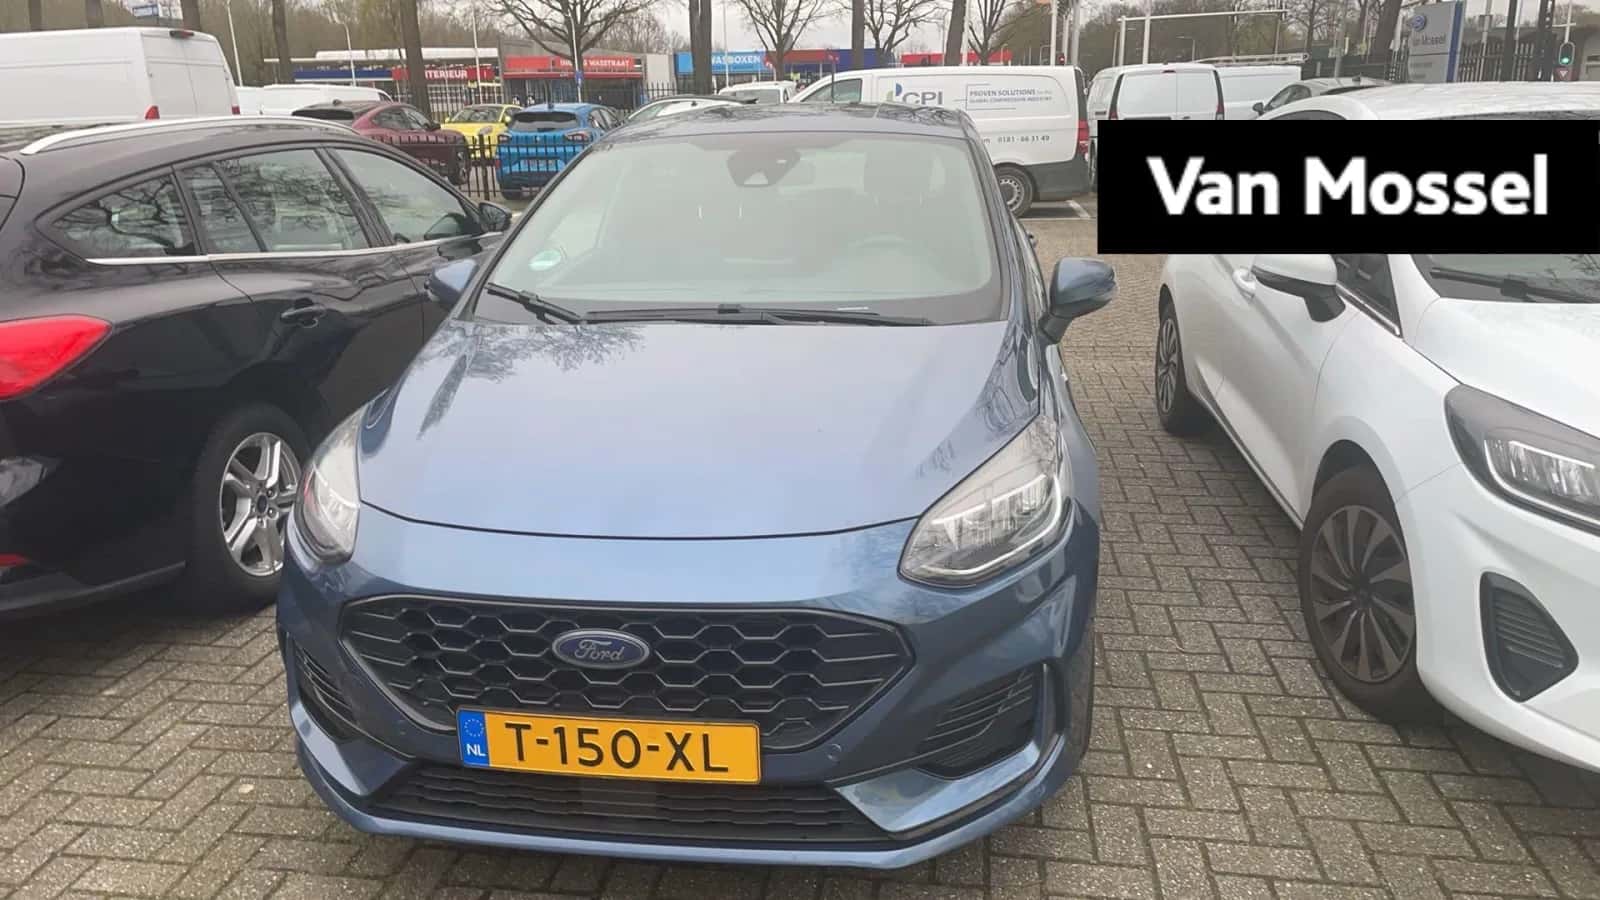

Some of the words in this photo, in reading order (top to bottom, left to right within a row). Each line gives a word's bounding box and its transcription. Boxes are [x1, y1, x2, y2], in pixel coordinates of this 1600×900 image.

[902, 91, 943, 105] CPI
[969, 89, 997, 97] PROVEN
[998, 88, 1036, 97] SOLUTIONS
[574, 639, 625, 661] Ford
[466, 743, 486, 757] NL
[505, 722, 729, 772] T-150-XL
